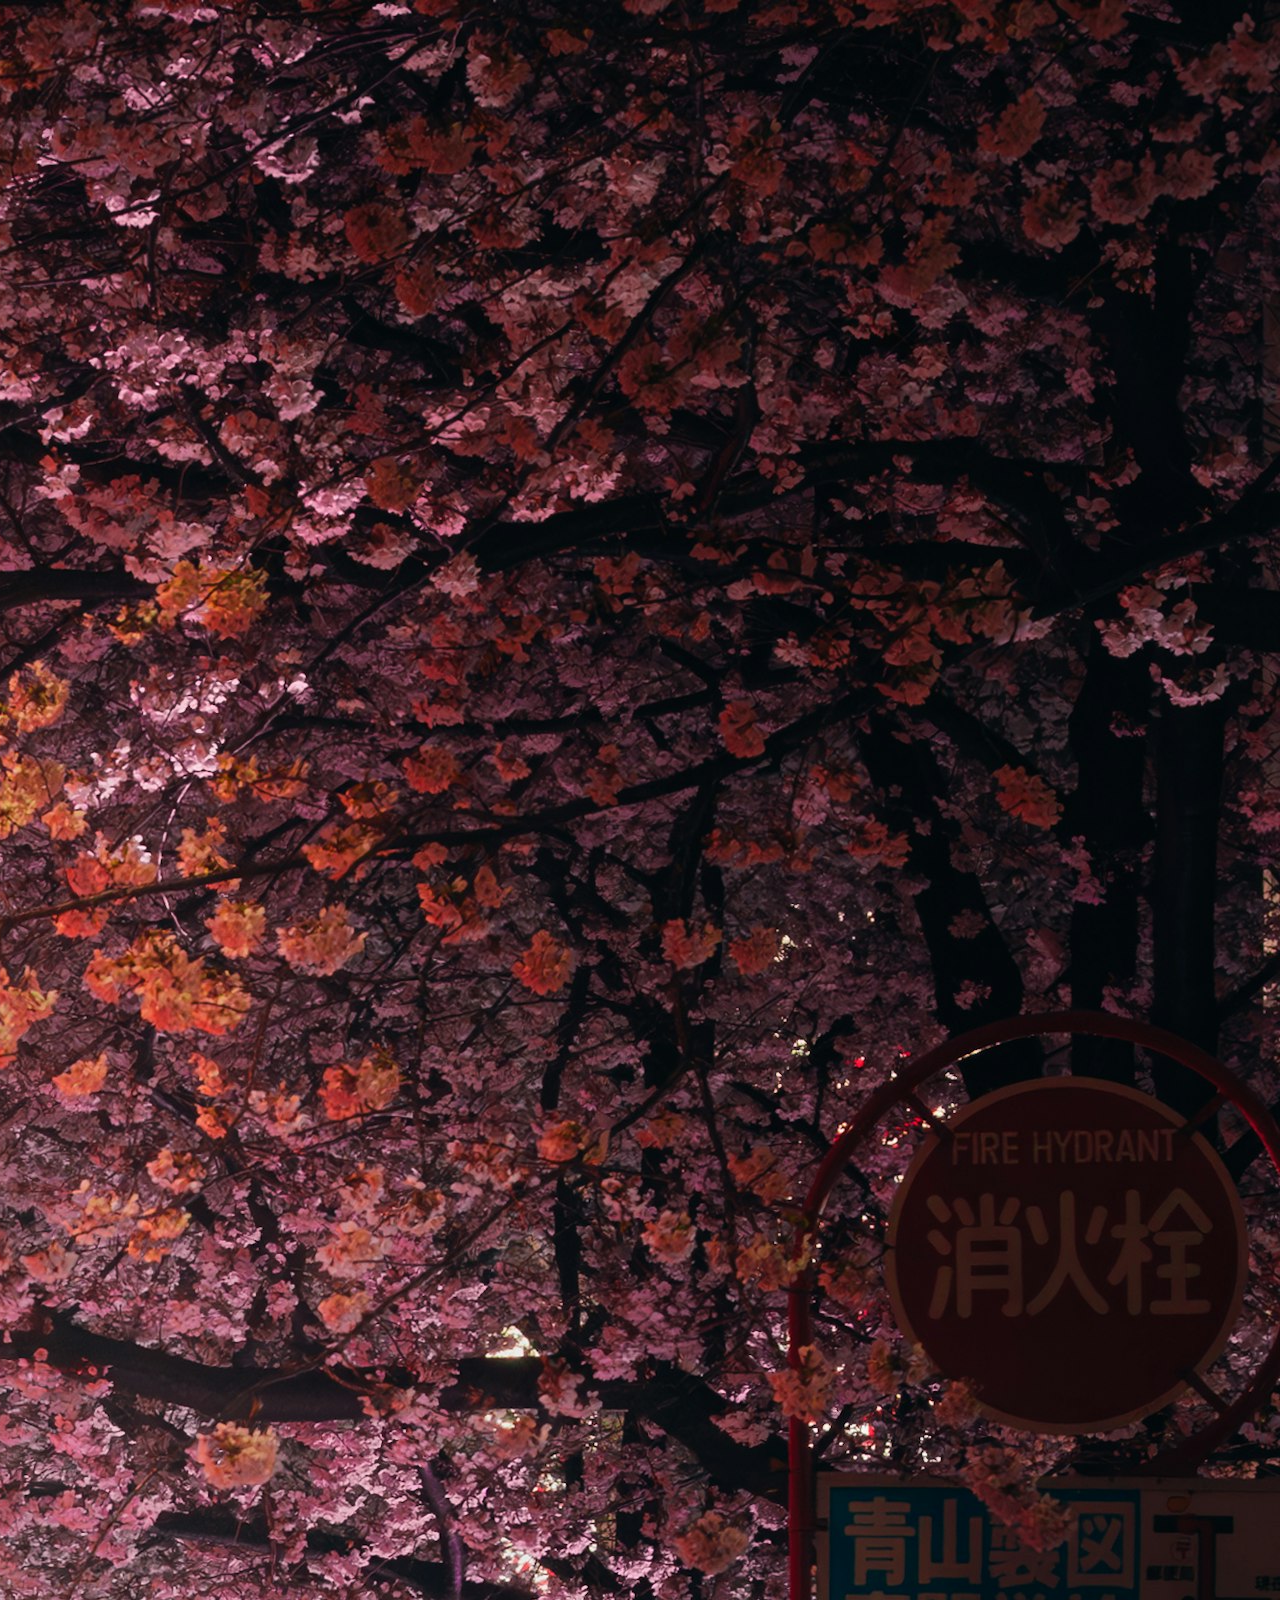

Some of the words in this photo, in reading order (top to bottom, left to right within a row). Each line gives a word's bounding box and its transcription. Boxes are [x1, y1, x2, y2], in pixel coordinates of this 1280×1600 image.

[951, 1131, 1019, 1165] FIRE
[1032, 1129, 1179, 1164] HYDRANT
[926, 1187, 1214, 1320] 消火栓
